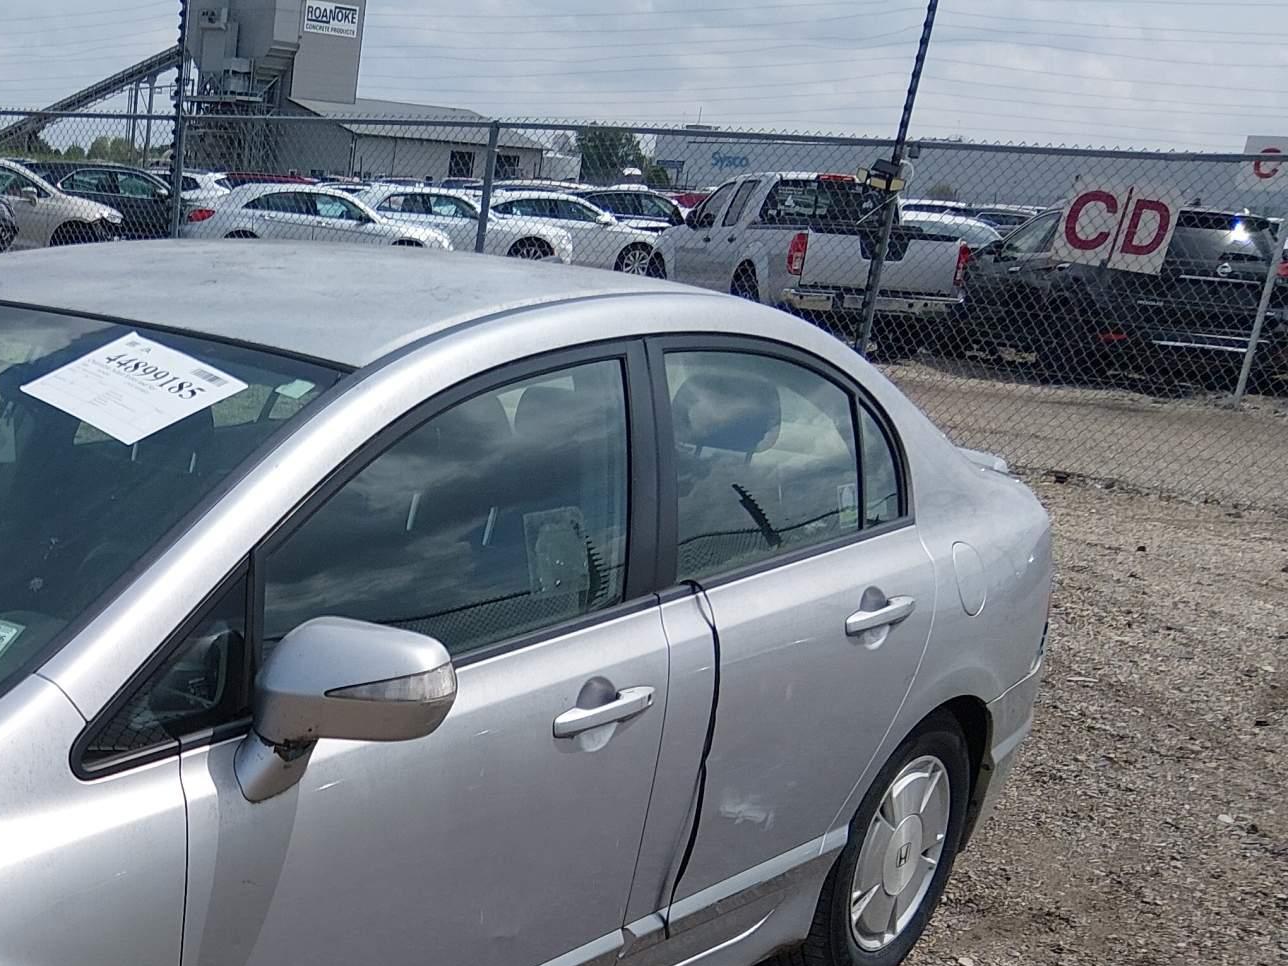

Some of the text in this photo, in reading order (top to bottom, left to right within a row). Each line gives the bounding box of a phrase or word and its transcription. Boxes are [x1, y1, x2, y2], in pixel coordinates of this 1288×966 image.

[307, 5, 357, 24] ROANOKE
[712, 151, 749, 170] Sysco
[1253, 147, 1281, 179] C
[105, 353, 206, 400] 44899185
